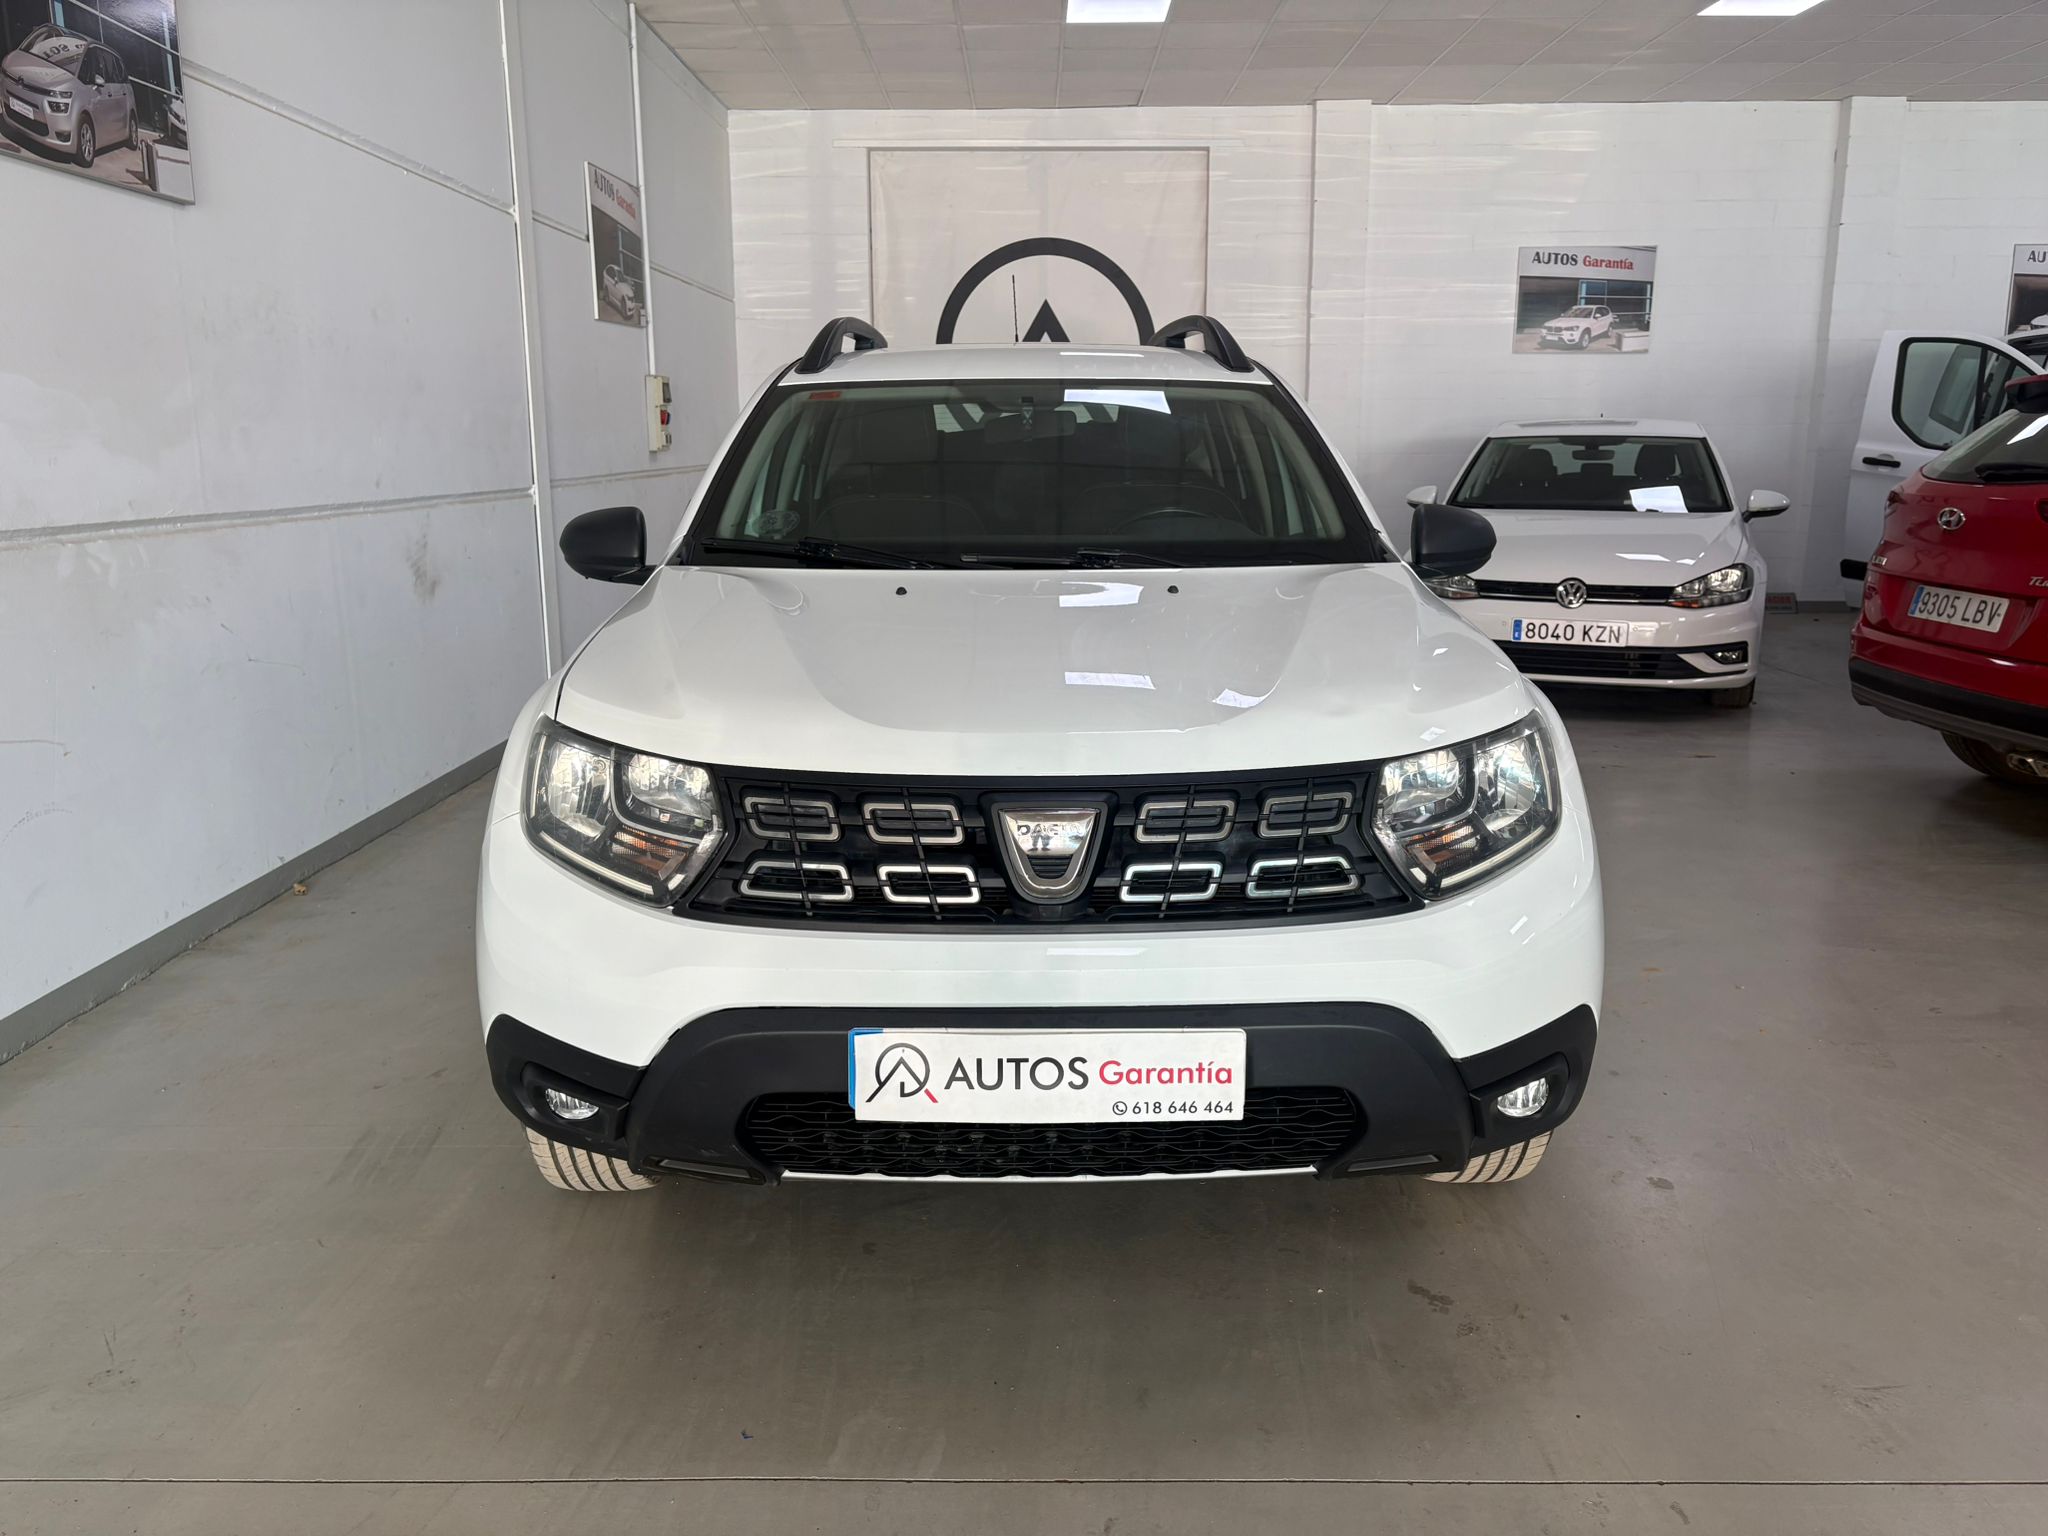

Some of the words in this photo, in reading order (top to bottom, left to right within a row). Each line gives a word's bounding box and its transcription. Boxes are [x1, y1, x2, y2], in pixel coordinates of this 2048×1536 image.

[594, 168, 615, 201] AUTOS
[1532, 251, 1578, 266] AUTOS
[1583, 254, 1634, 270] Garantía
[2027, 250, 2048, 263] AU
[1918, 591, 1961, 619] 9305
[1961, 597, 2003, 627] LBV
[1525, 622, 1575, 641] 8040
[1582, 624, 1621, 644] KZN
[944, 1056, 1089, 1090] AUTOS
[1099, 1060, 1233, 1087] Garantía
[1132, 1101, 1162, 1115] 618
[1168, 1101, 1198, 1114] 646
[1203, 1101, 1233, 1114] 464
